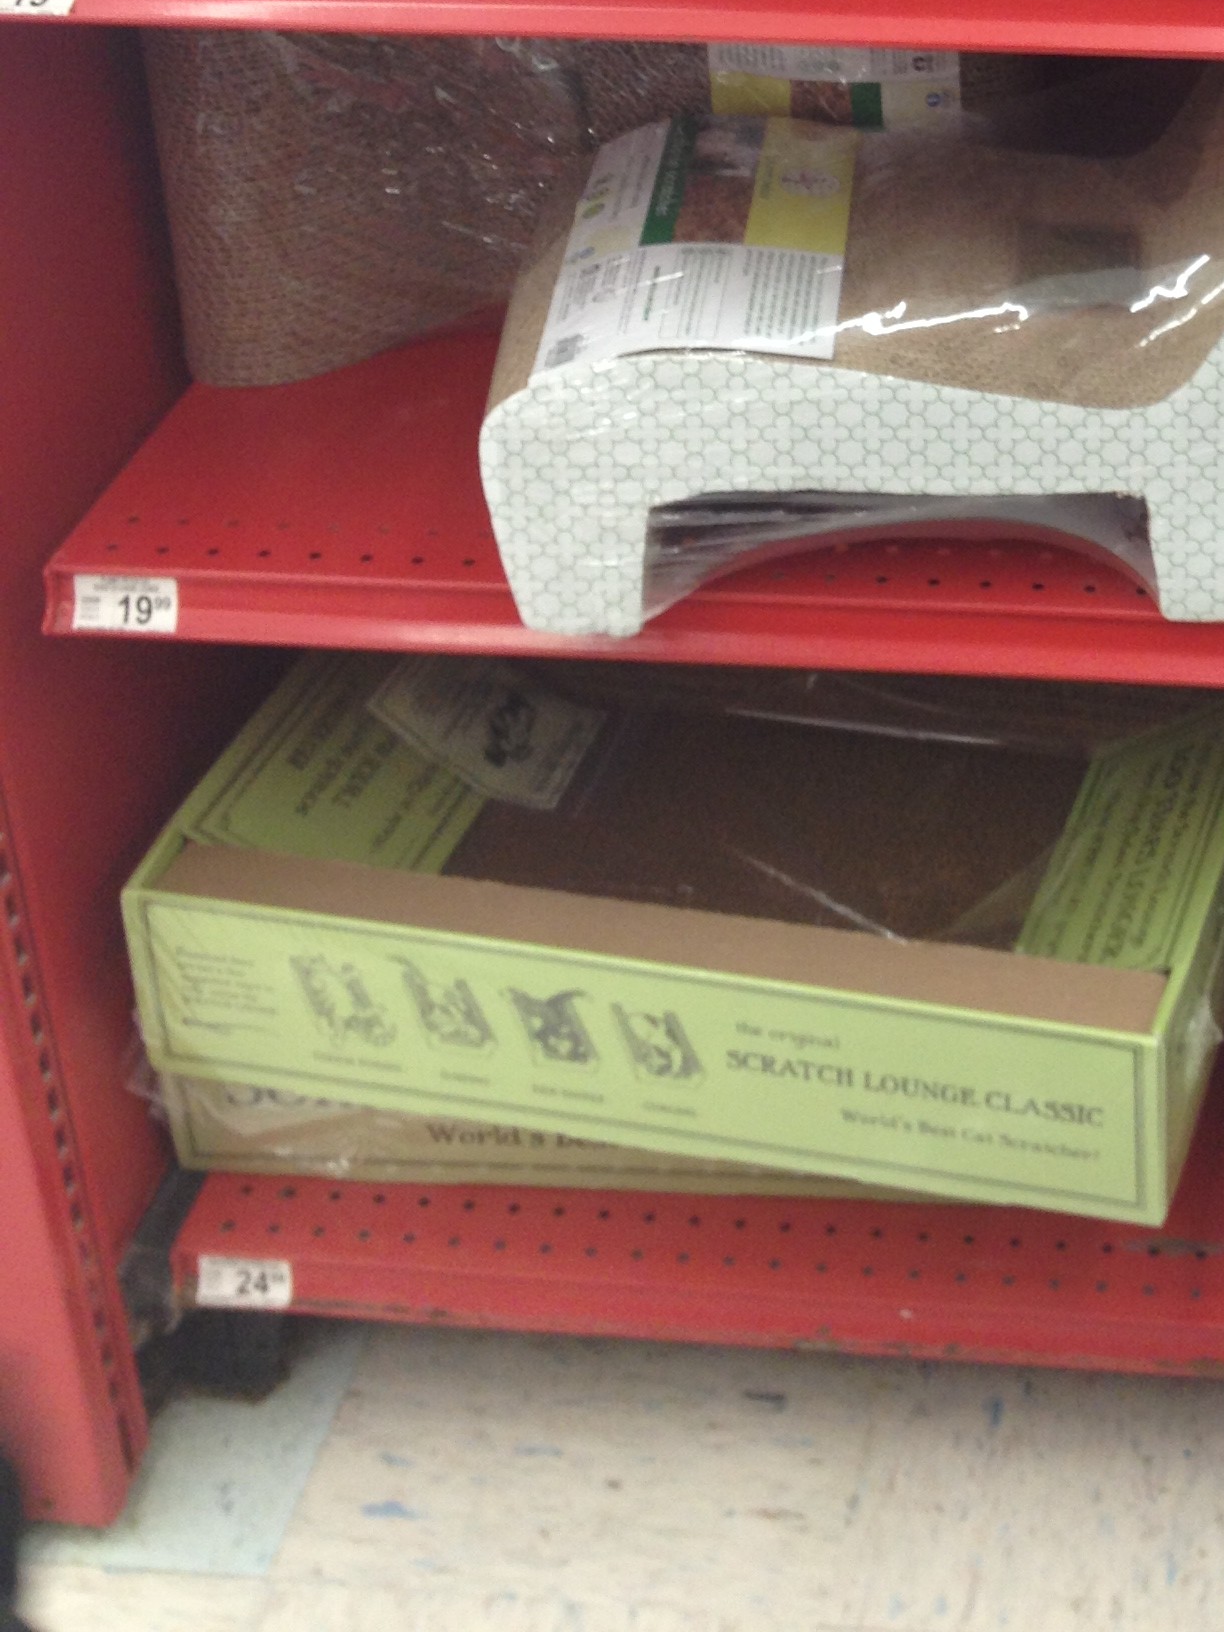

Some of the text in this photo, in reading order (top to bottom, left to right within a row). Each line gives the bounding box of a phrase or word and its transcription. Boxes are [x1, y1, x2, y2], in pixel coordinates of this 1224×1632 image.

[725, 1049, 1105, 1128] SCRATCH LOUNGE CLASSIC
